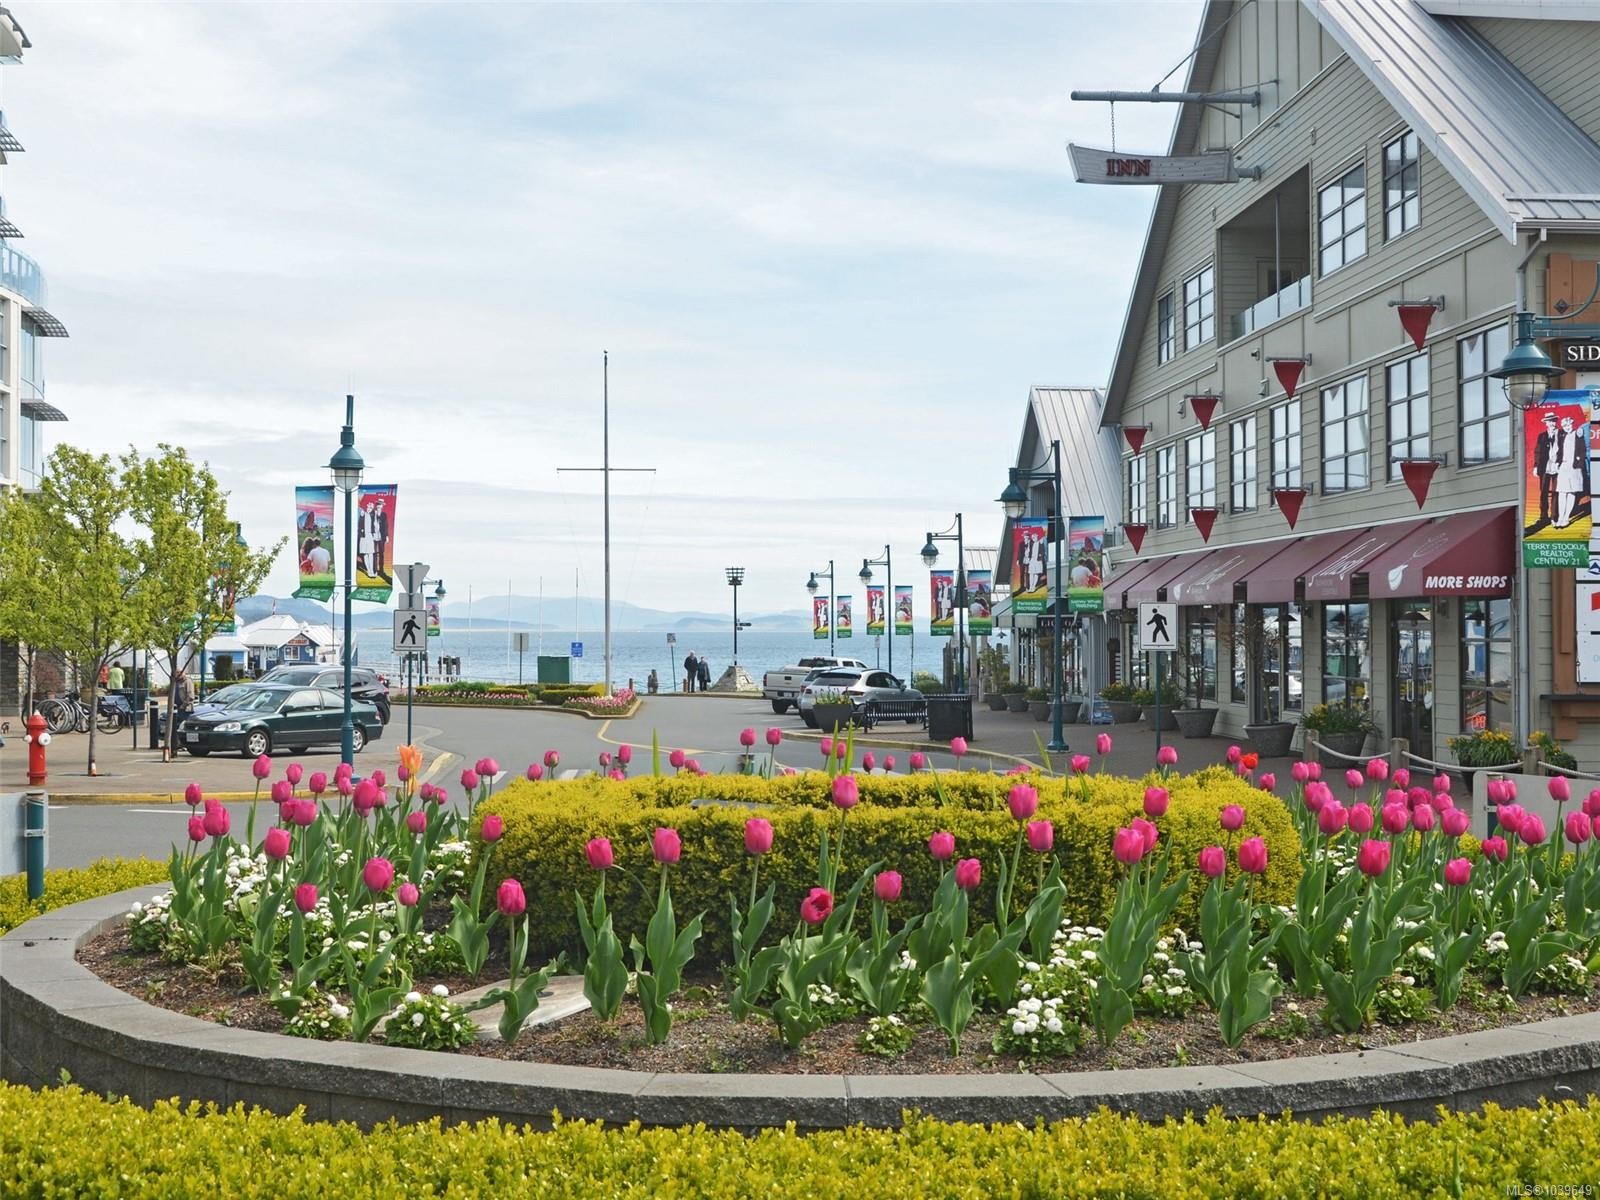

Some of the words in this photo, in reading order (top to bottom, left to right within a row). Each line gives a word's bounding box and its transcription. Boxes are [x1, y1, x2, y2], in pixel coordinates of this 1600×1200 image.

[1106, 158, 1151, 176] INN
[1425, 575, 1464, 589] MORE
[1466, 575, 1508, 589] SHOPS
